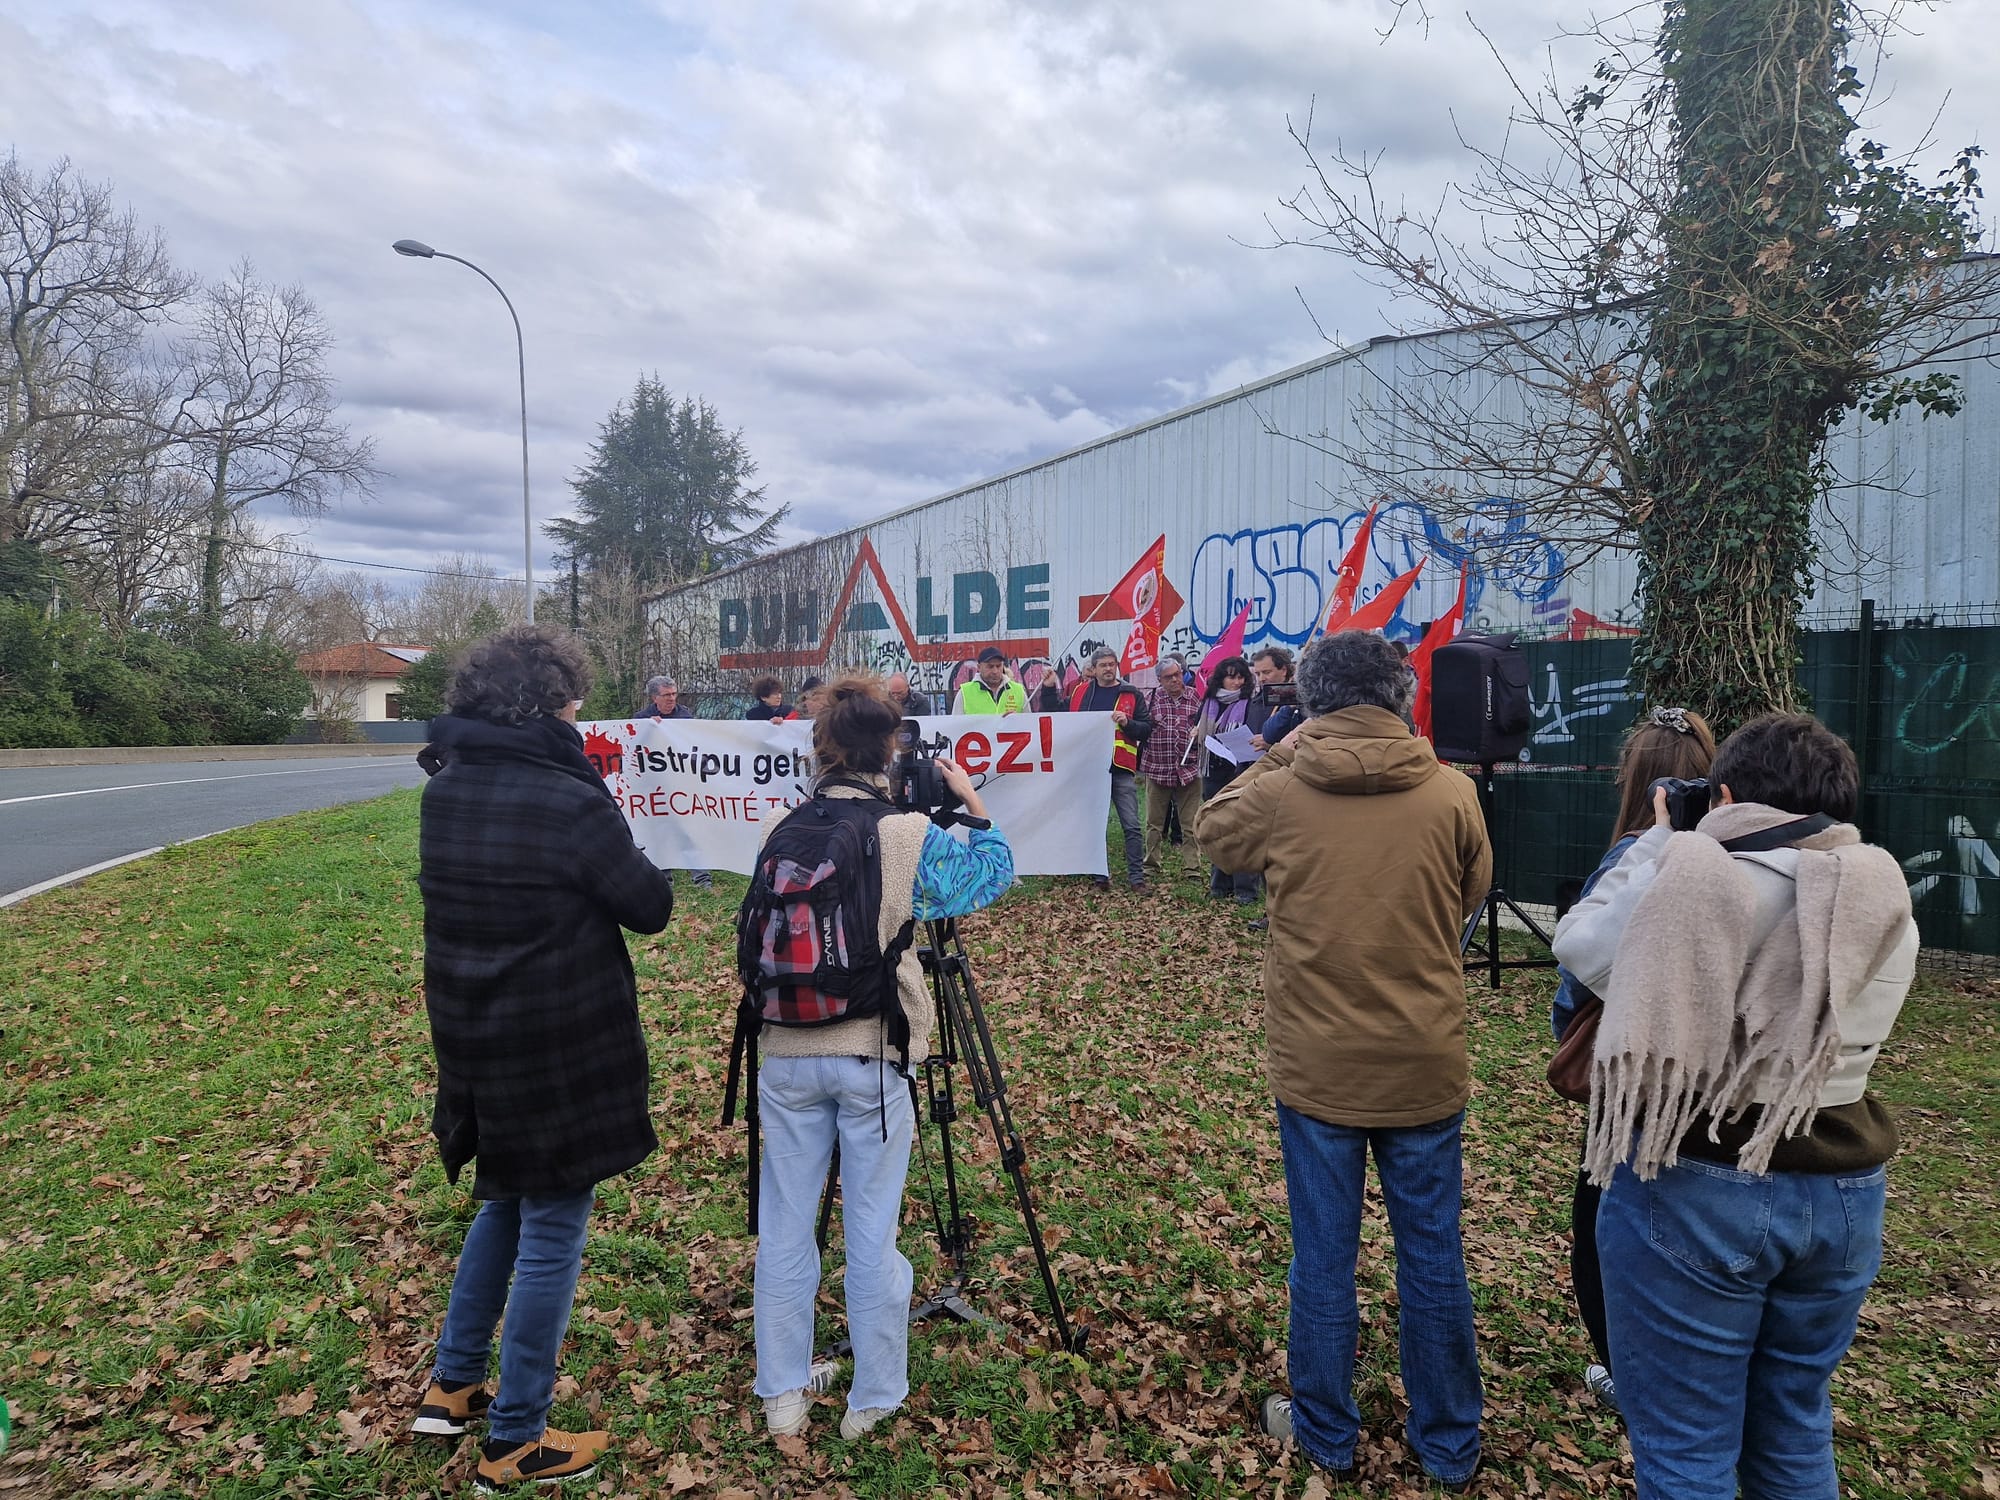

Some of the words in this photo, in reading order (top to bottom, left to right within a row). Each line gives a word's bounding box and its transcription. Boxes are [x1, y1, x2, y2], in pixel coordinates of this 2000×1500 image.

[719, 535, 1050, 650] DUHALDE
[1128, 622, 1155, 669] cgt
[635, 745, 741, 782] istripu
[753, 747, 811, 784] geh
